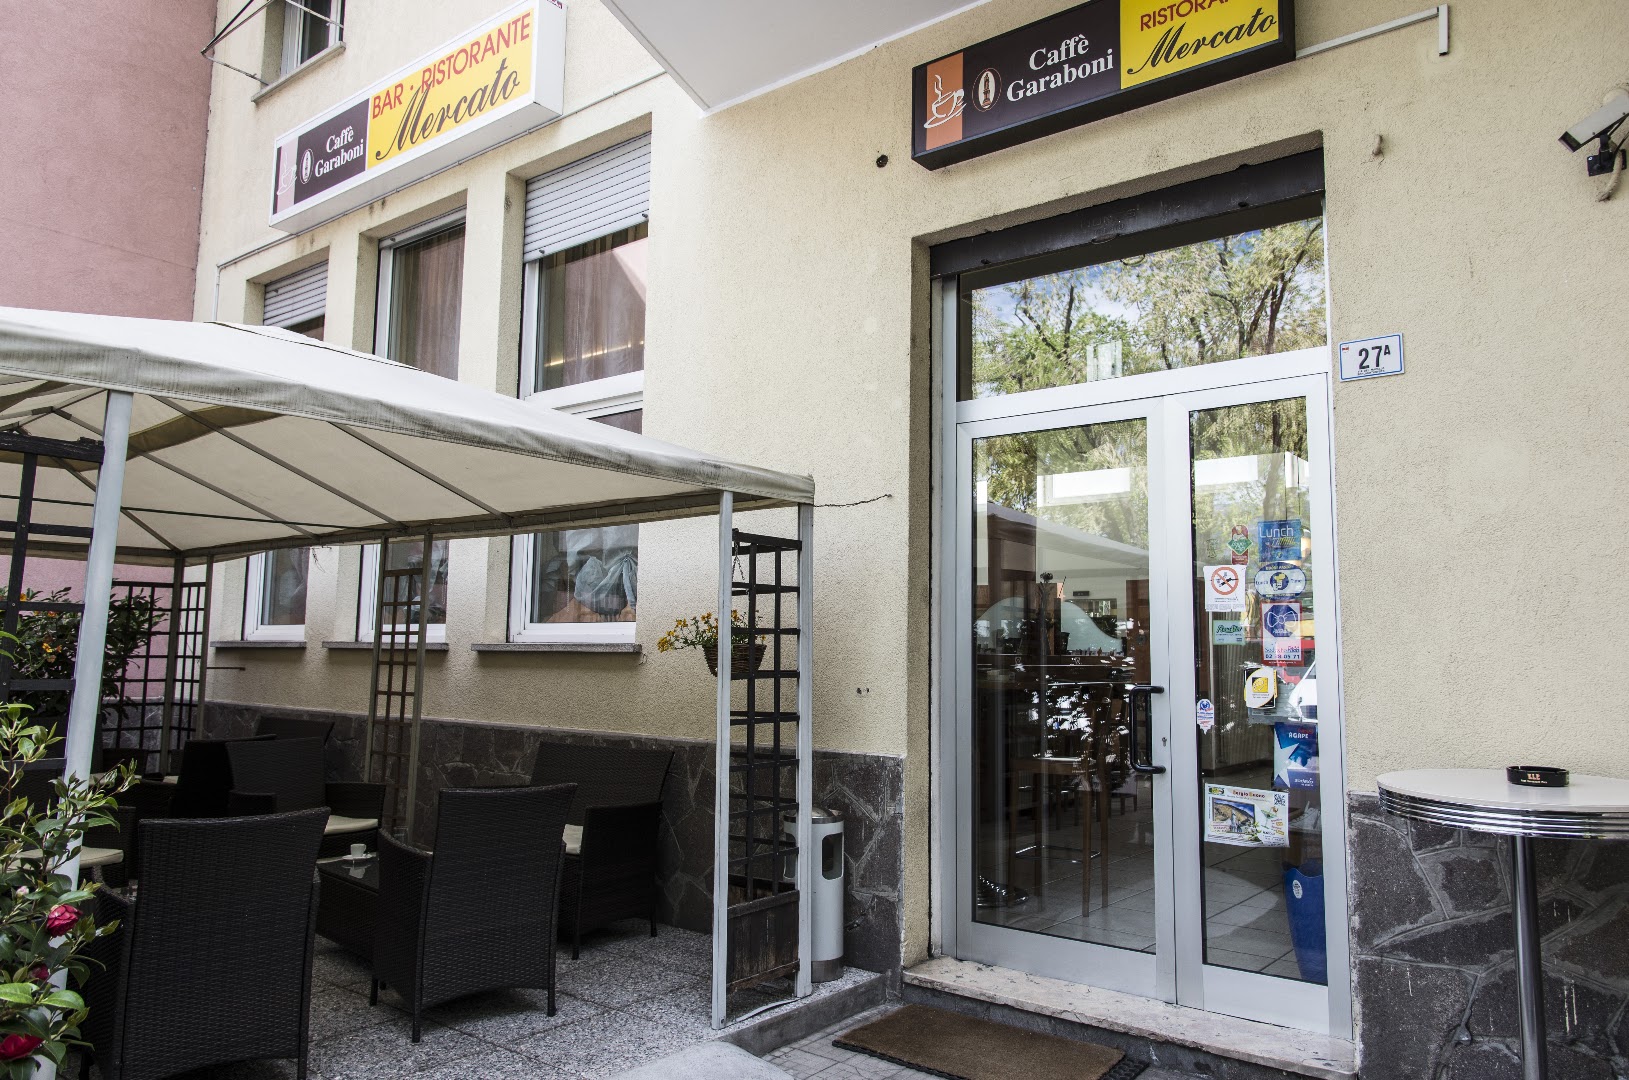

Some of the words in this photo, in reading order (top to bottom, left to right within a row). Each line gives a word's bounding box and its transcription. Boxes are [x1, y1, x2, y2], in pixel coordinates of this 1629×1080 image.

[1140, 0, 1229, 32] RISTOR
[1029, 33, 1090, 71] Caffè
[1127, 7, 1277, 74] Mercato
[372, 83, 404, 119] BAR
[420, 12, 531, 94] RISTORANTE
[1006, 48, 1114, 102] Garaboni
[375, 57, 521, 161] Mercato
[314, 139, 364, 178] Garaboni
[326, 125, 354, 153] Caffè
[1259, 525, 1294, 538] Lunch
